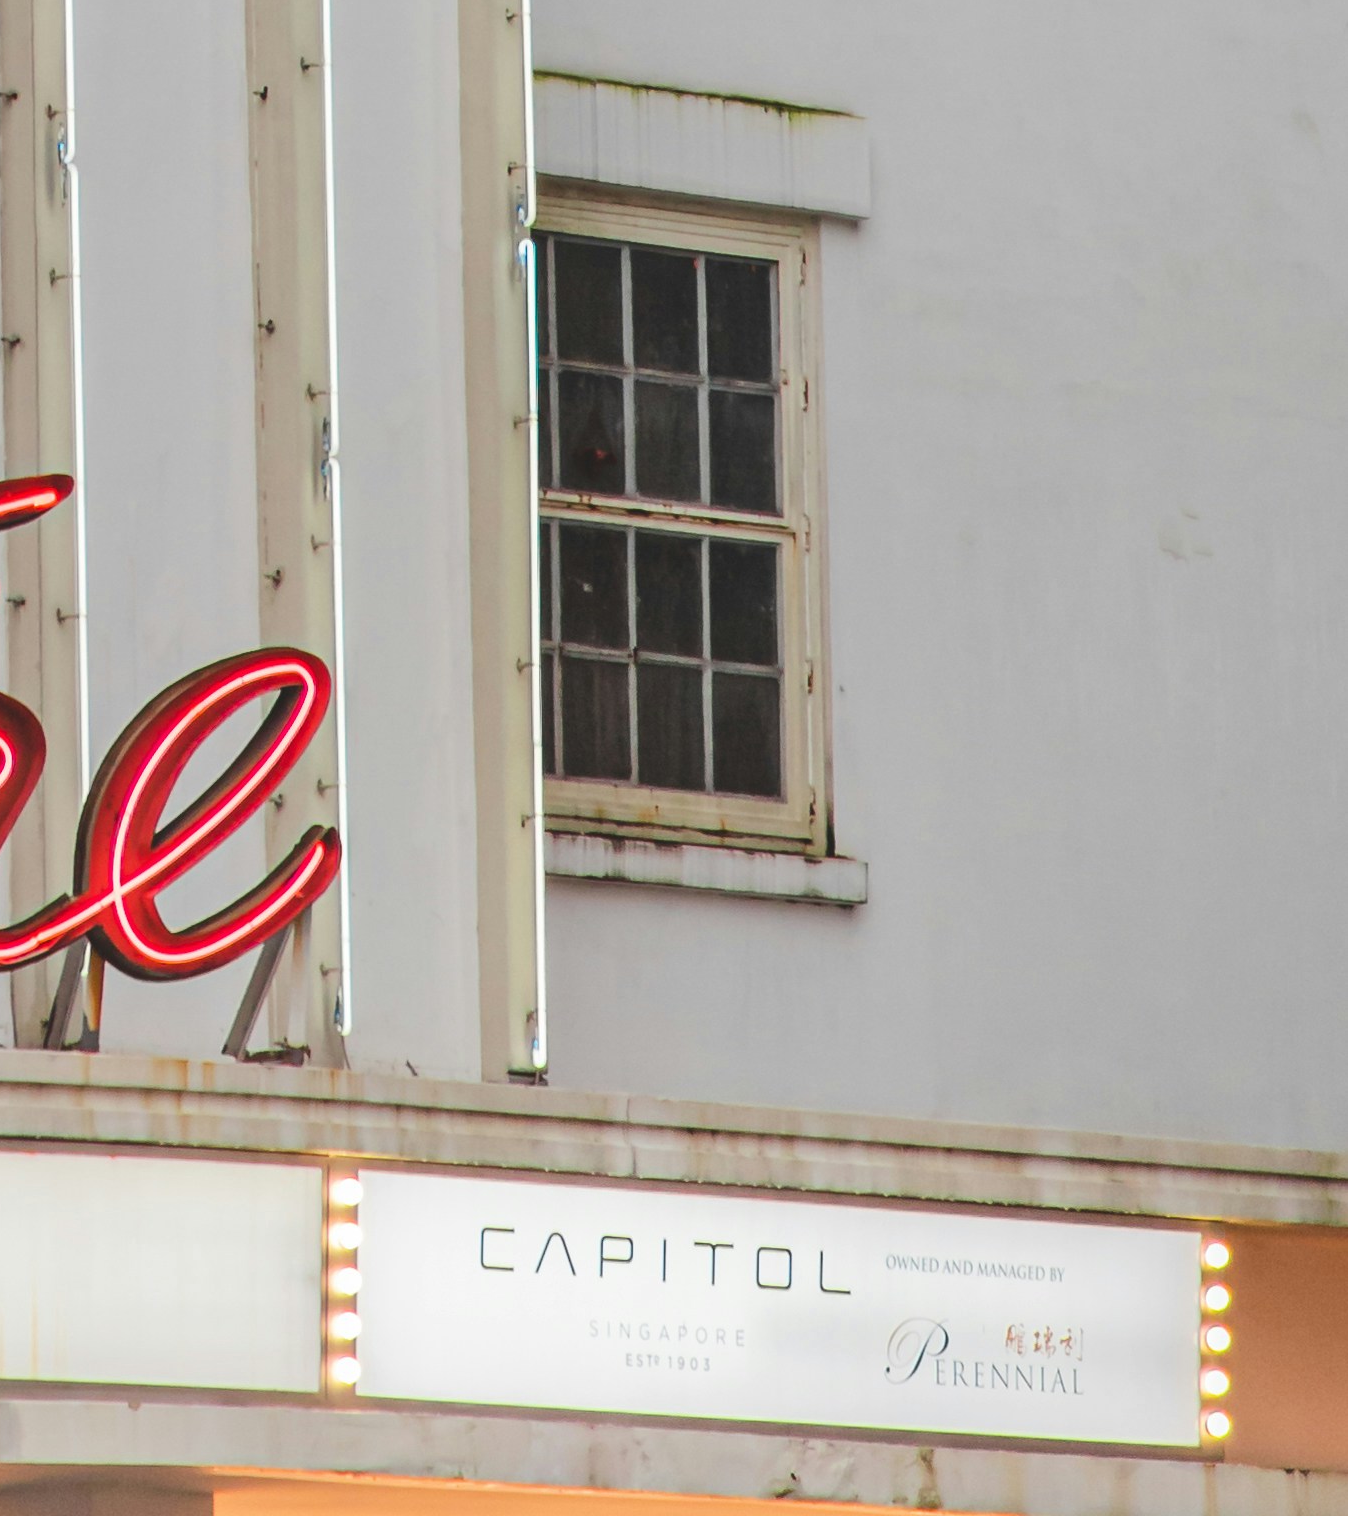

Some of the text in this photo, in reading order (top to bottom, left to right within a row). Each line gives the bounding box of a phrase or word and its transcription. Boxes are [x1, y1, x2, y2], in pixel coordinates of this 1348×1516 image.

[480, 1227, 852, 1295] CAPITOL
[885, 1253, 1066, 1283] OWNED AND MANAGED BY
[588, 1318, 746, 1347] SINGAPORE
[668, 1355, 711, 1373] 1903
